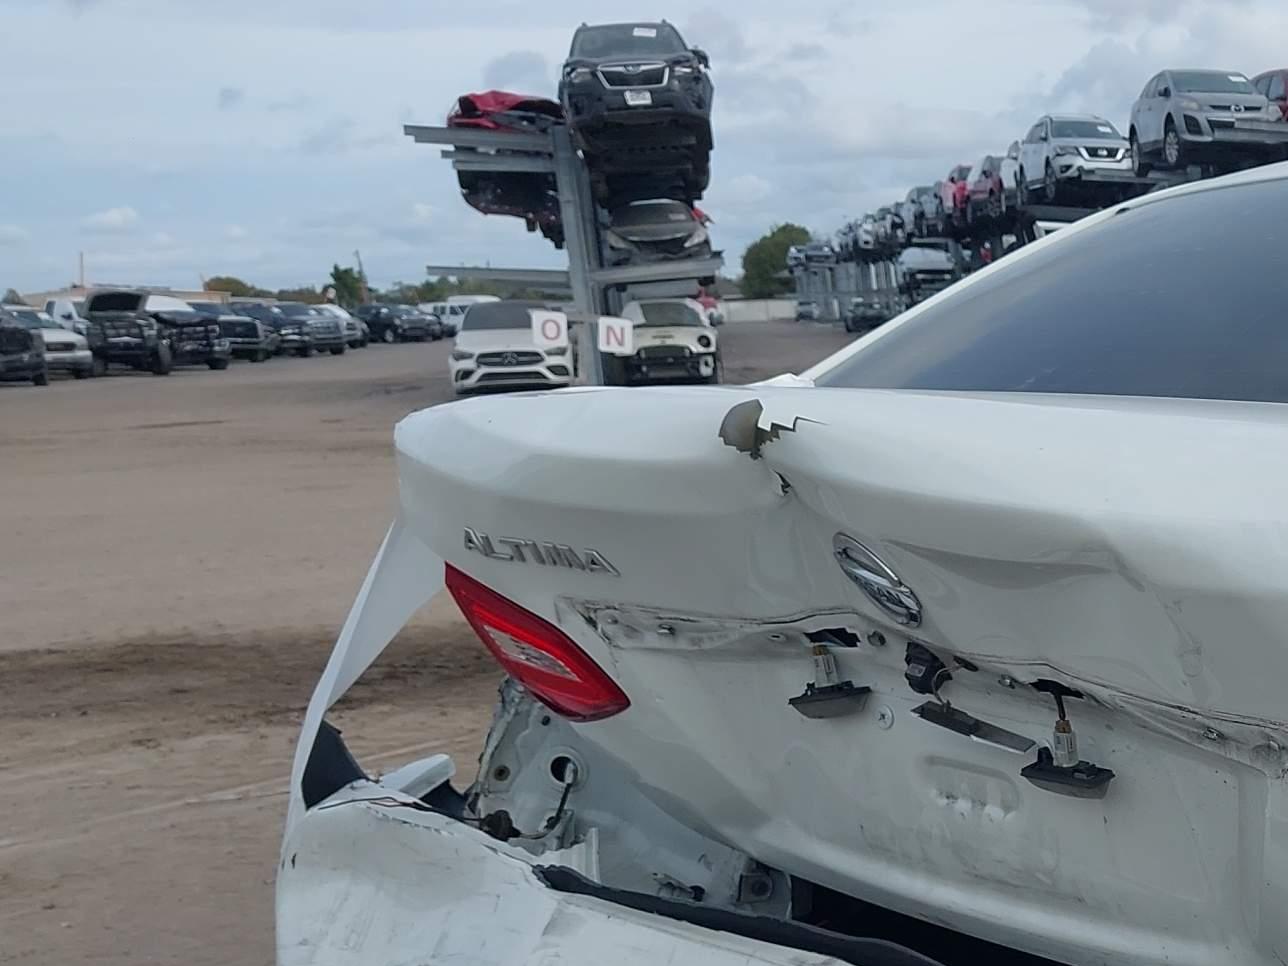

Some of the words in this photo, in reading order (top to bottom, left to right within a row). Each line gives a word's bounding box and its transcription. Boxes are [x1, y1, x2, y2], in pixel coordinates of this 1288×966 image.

[542, 319, 560, 341] O
[606, 325, 625, 347] N
[464, 527, 621, 577] ALTIMA
